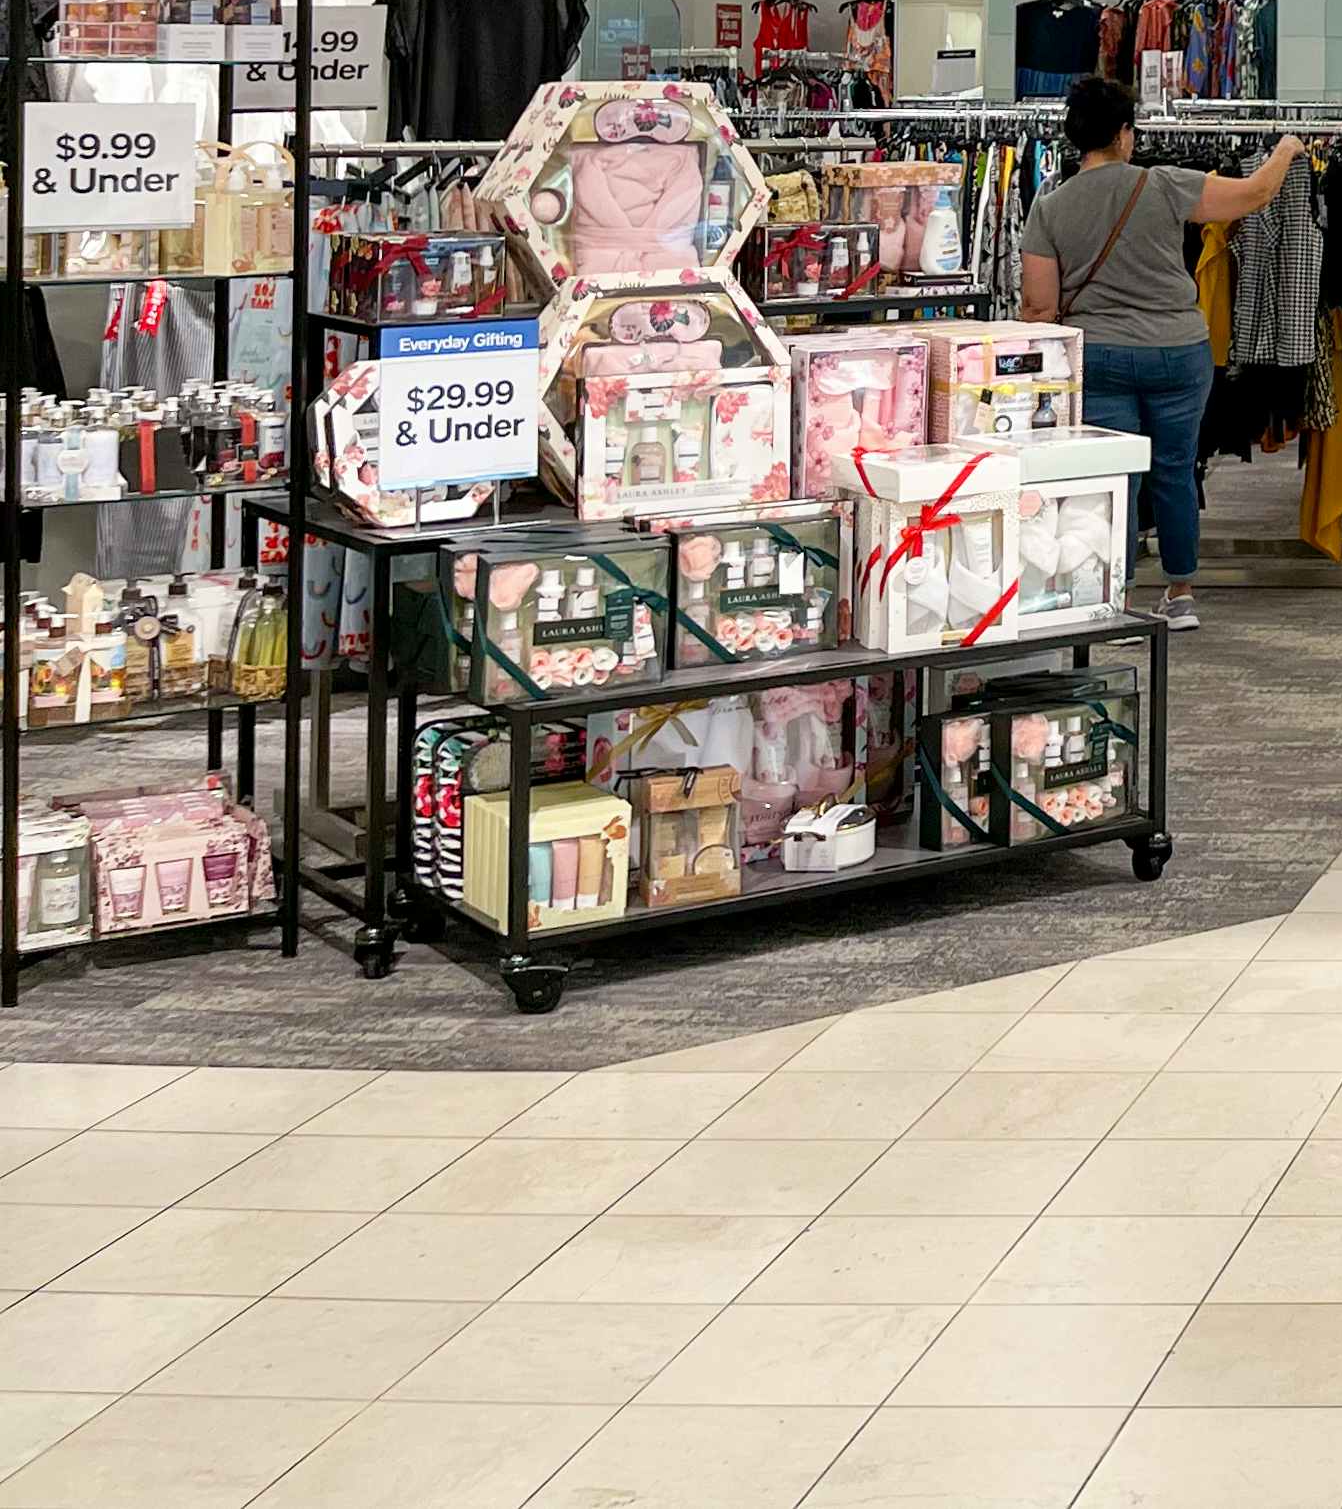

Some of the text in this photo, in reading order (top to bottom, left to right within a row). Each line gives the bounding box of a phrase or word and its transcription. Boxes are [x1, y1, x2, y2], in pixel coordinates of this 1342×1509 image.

[246, 63, 267, 82] &
[55, 132, 157, 163] $9.99
[32, 166, 180, 195] & Under
[398, 330, 524, 353] Everyday Gifting
[406, 379, 515, 414] $29.99
[395, 414, 526, 447] & Under
[727, 593, 758, 604] LAURA
[541, 626, 576, 638] LAURA
